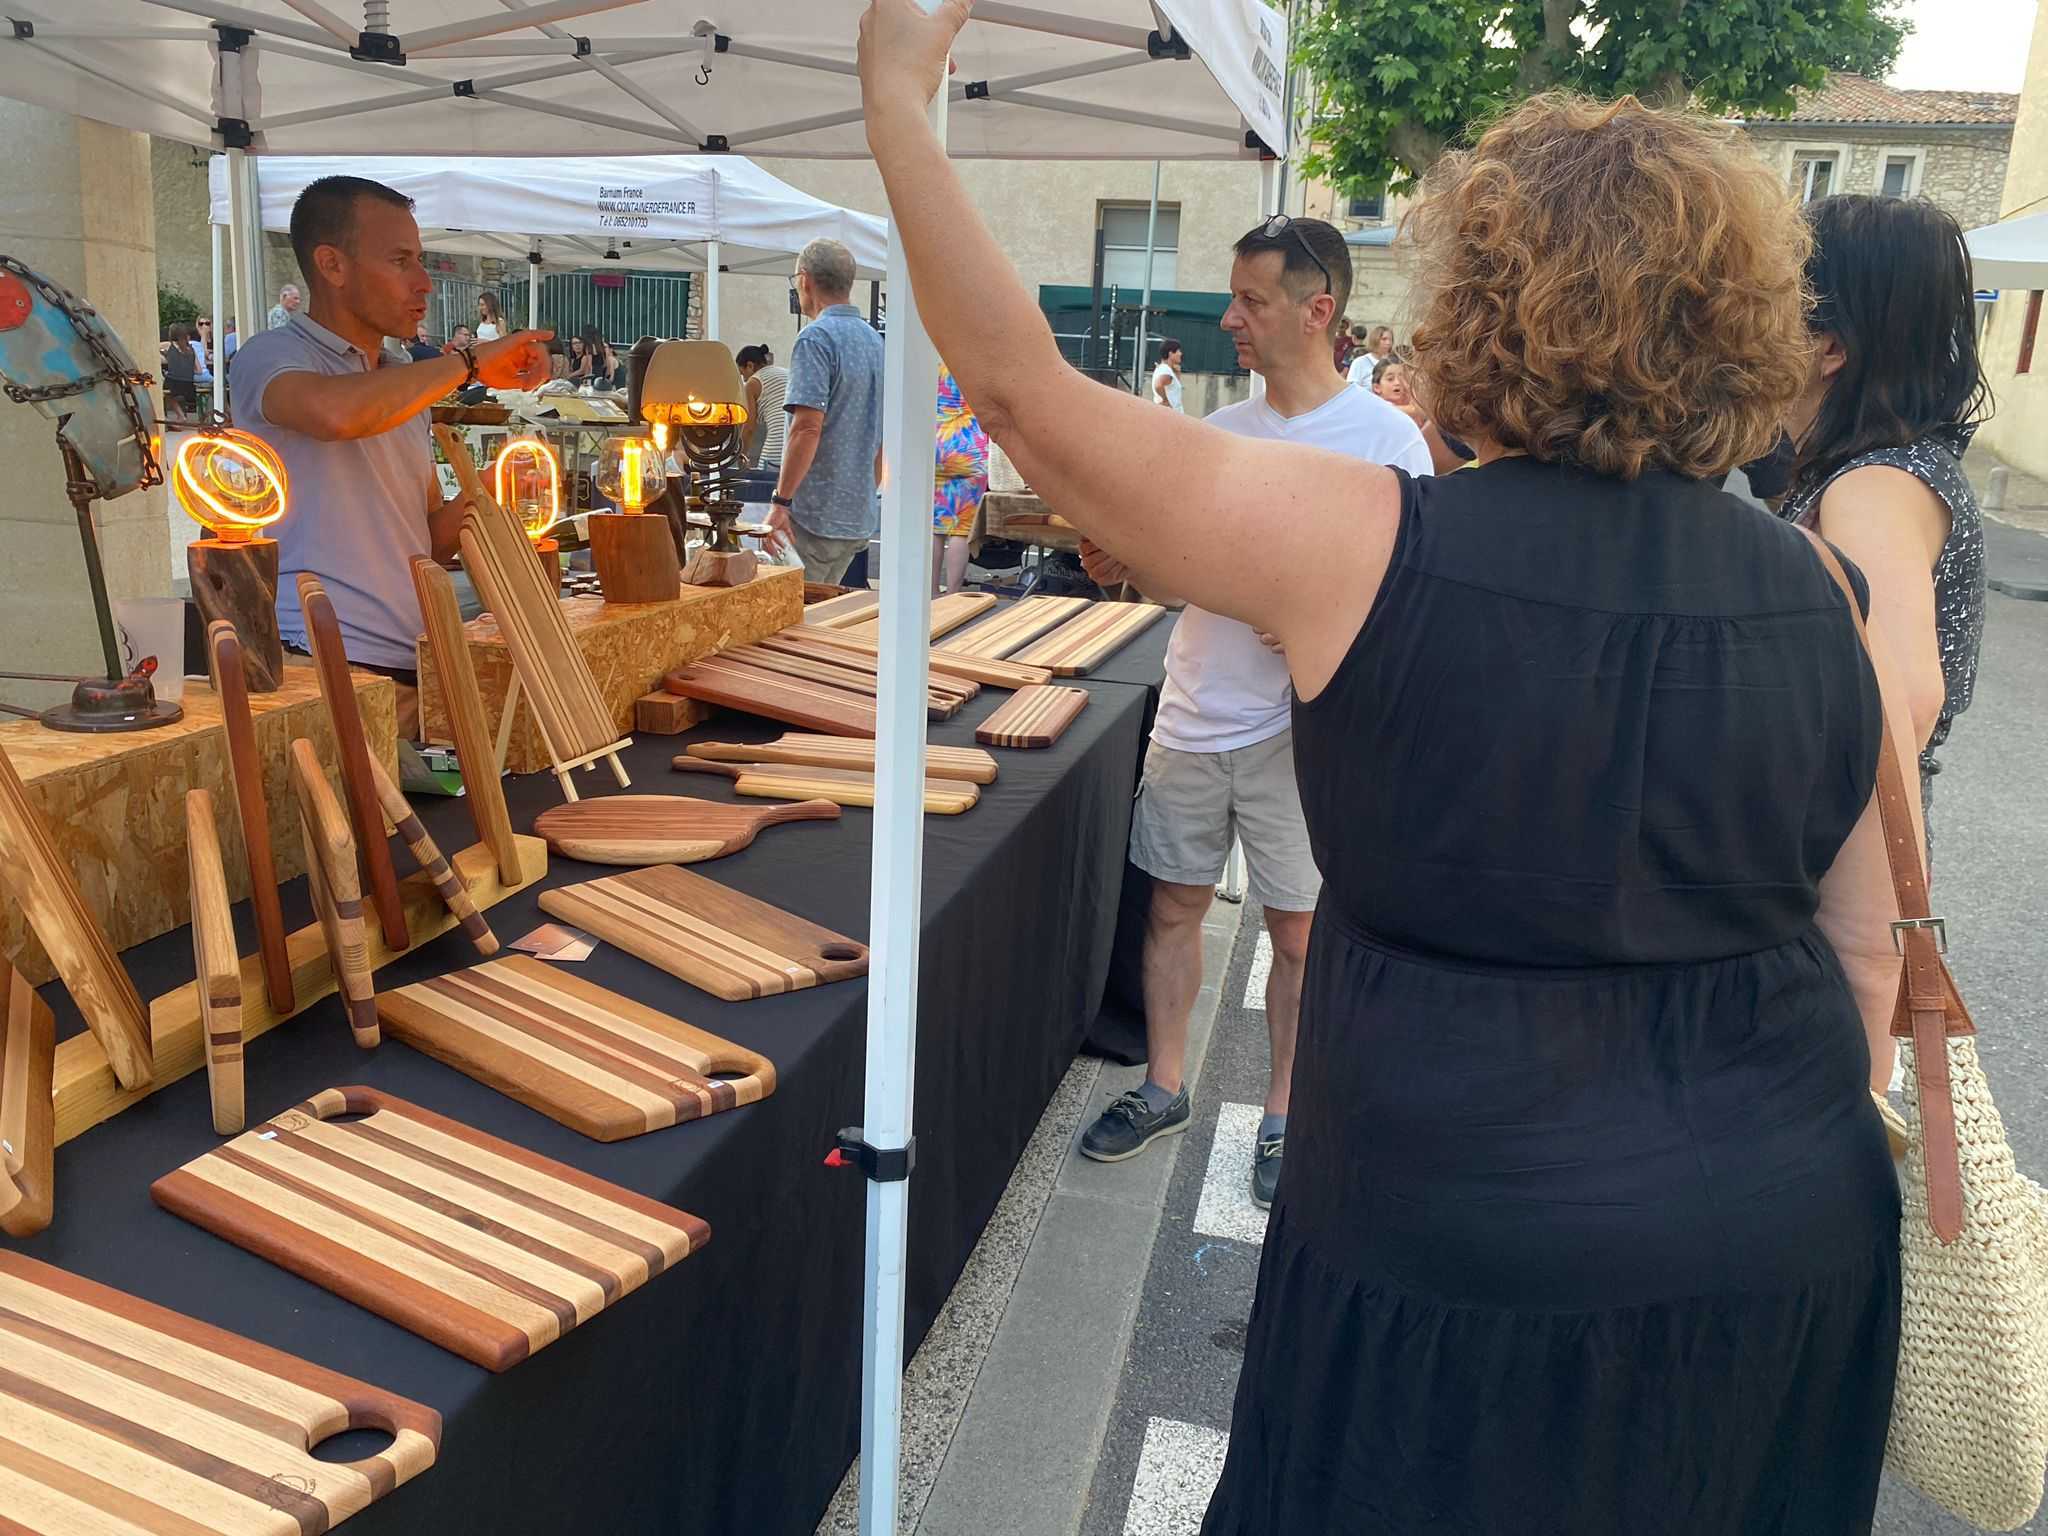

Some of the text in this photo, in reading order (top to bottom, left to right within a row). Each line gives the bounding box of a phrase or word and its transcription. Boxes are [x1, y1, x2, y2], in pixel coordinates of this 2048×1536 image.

[599, 186, 643, 199] Barnum France
[597, 200, 696, 215] WWW.CONTAINERDEFRANCE.FR
